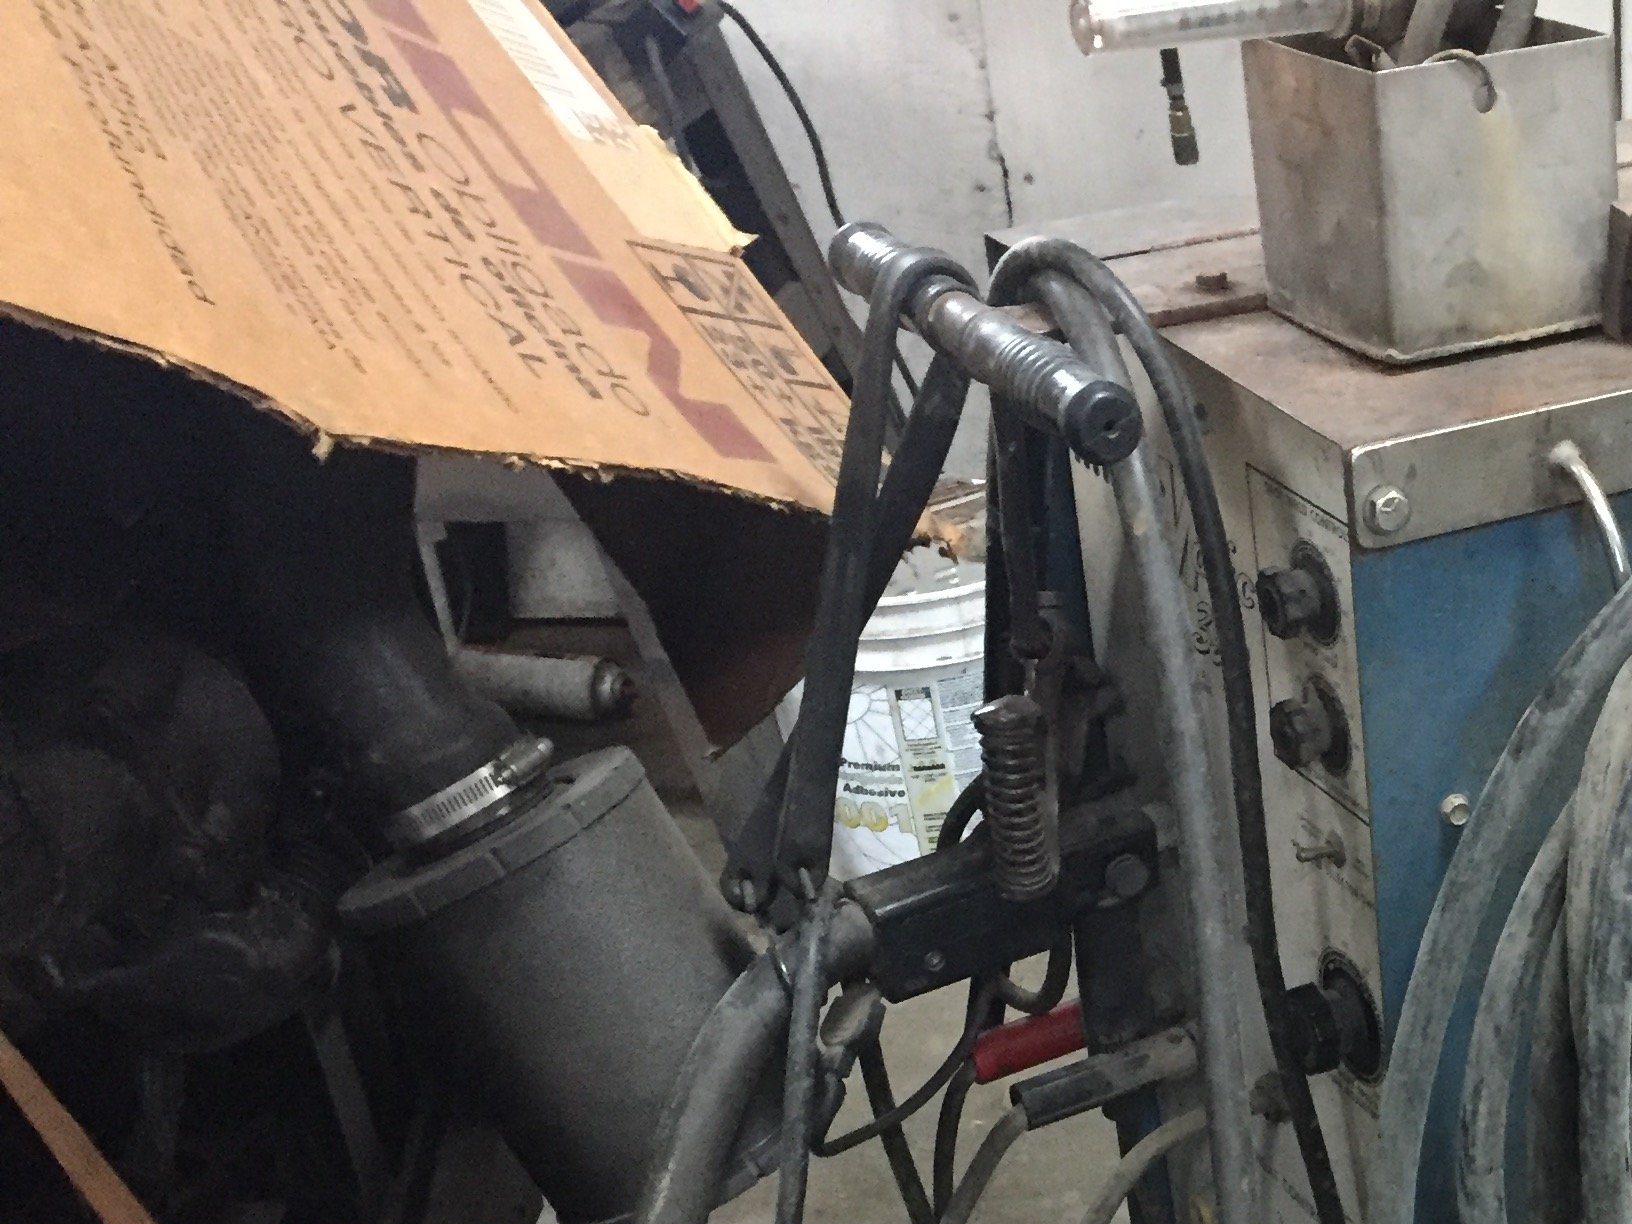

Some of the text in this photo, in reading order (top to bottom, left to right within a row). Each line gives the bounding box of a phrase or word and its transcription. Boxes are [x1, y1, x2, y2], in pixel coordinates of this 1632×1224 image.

[60, 51, 216, 307] Profundidad
[338, 102, 546, 379] VERTICAL
[416, 131, 649, 417] Obligado
[430, 187, 476, 242] de
[481, 257, 602, 399] oficina
